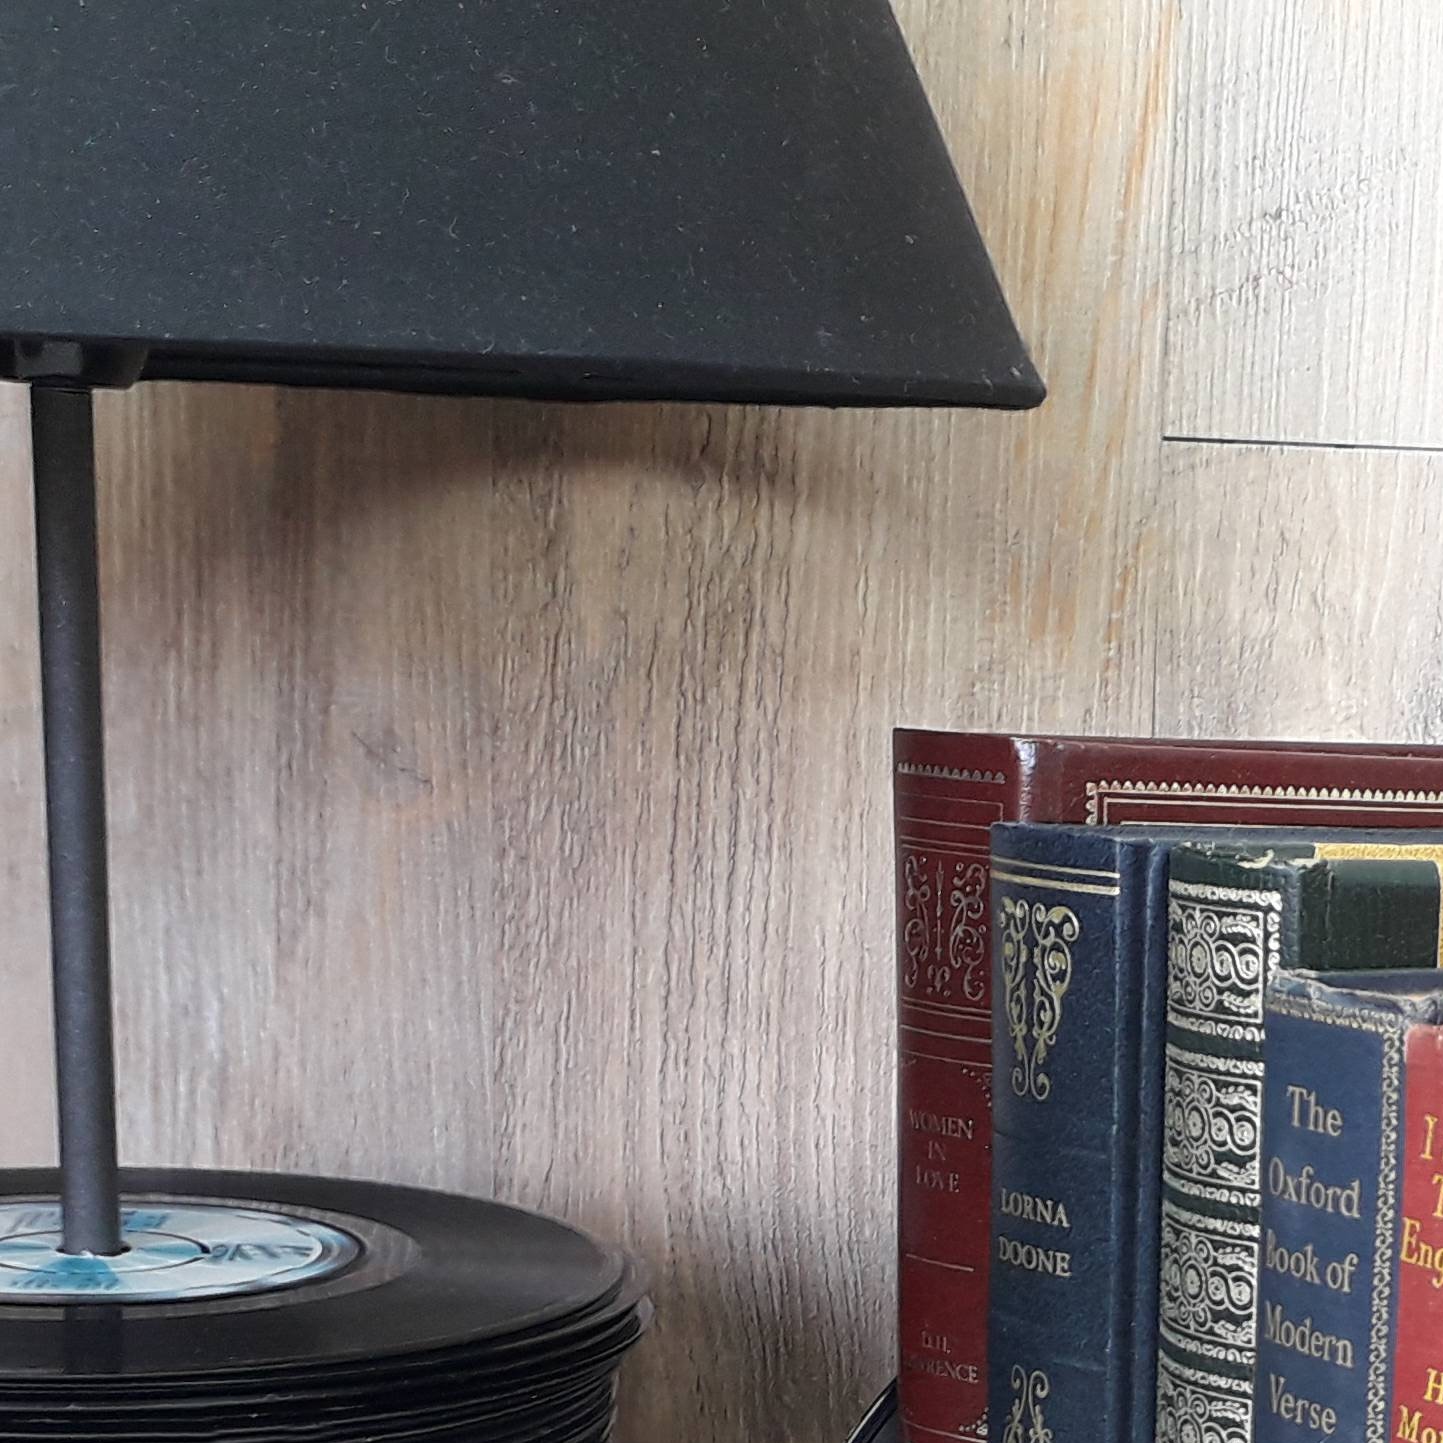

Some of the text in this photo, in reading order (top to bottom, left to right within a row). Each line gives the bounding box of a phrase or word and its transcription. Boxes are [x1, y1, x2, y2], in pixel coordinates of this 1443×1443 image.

[909, 1109, 974, 1140] WOMEN
[1287, 1085, 1343, 1136] The
[928, 1141, 946, 1160] IN
[1421, 1114, 1438, 1160] I
[916, 1165, 960, 1193] LOVE
[1268, 1157, 1361, 1218] Oxford
[1001, 1187, 1071, 1228] LORNA
[999, 1236, 1073, 1277] DOONE
[1266, 1228, 1358, 1293] Book of
[1265, 1300, 1355, 1368] Modern
[1269, 1373, 1337, 1435] Verse
